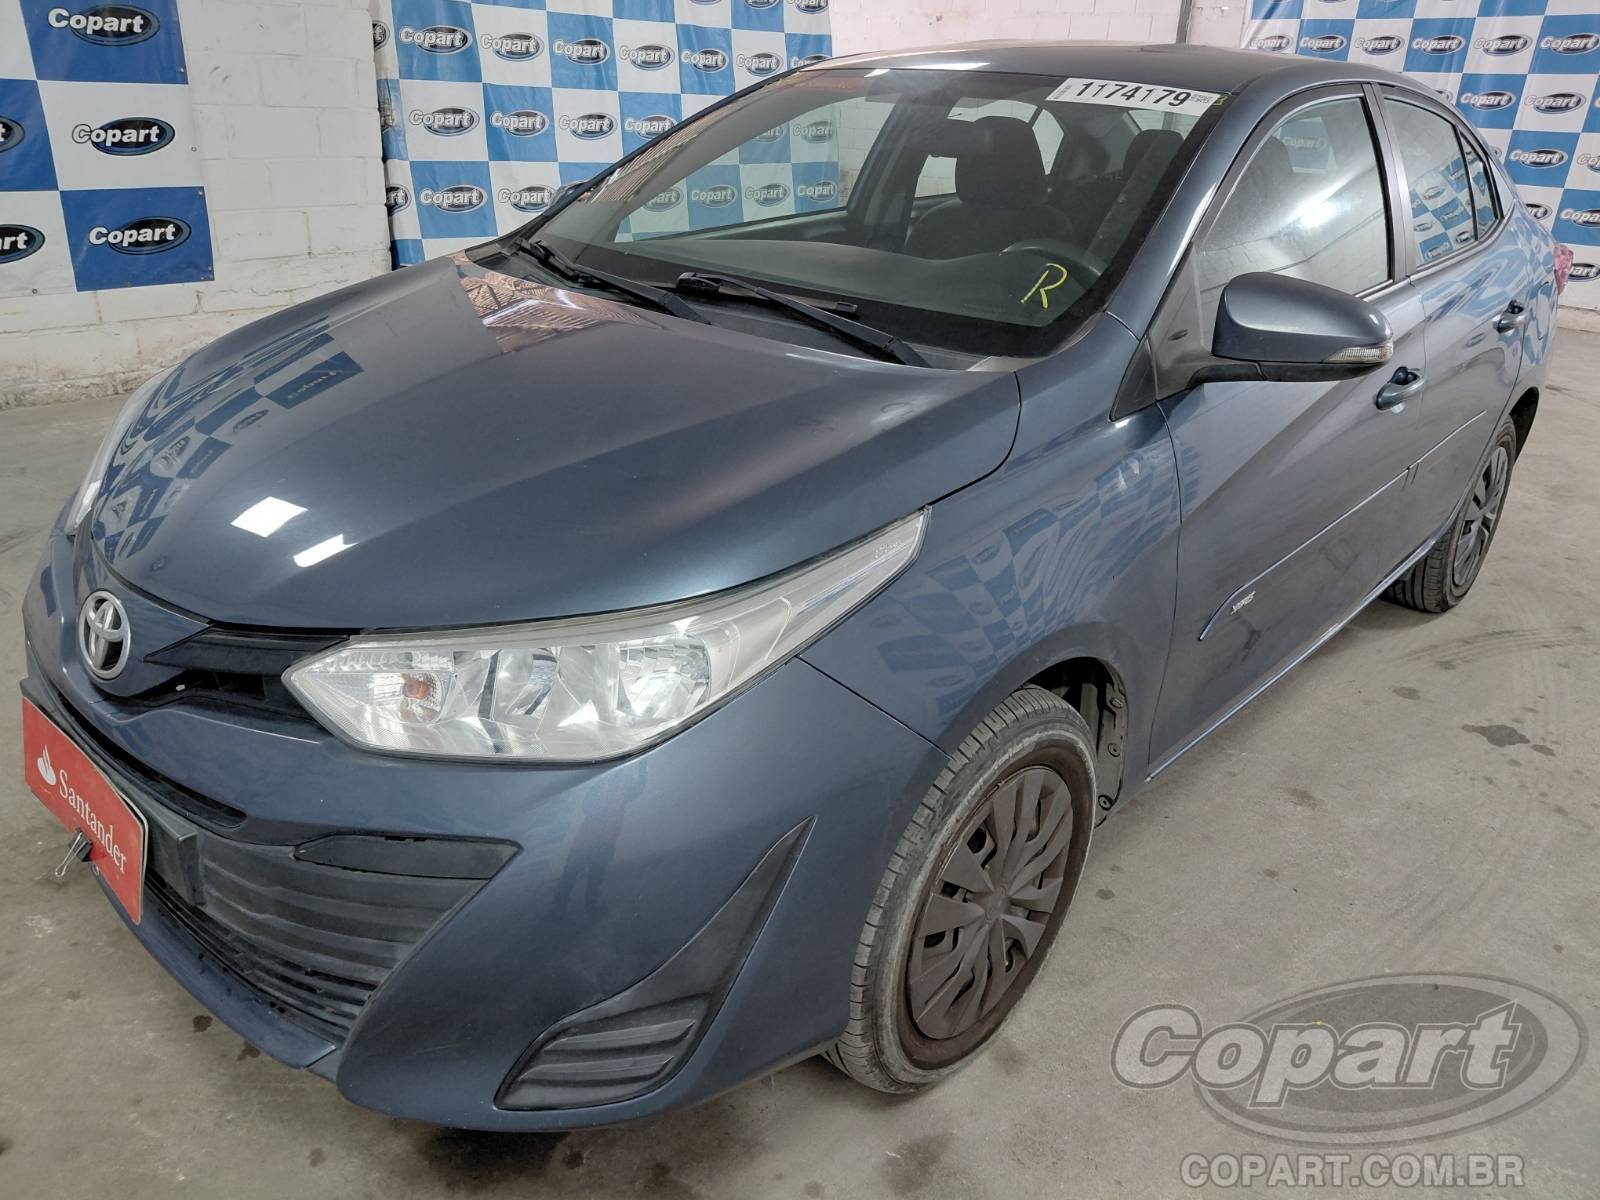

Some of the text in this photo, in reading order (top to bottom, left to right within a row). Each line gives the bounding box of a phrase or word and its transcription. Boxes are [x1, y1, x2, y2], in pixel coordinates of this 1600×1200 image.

[48, 8, 144, 34] Copart
[400, 27, 463, 47] Copart
[481, 34, 537, 54] Copart
[1300, 37, 1342, 50] Copart
[1354, 38, 1401, 51] Copart
[1412, 38, 1459, 51] Copart
[1474, 37, 1523, 51] Copart
[1541, 35, 1594, 50] Copart
[553, 40, 606, 60] Copart
[619, 46, 668, 63] Copart
[681, 51, 724, 67] Copart
[736, 54, 778, 72] Copart
[1076, 82, 1192, 107] 1174179
[1461, 91, 1509, 107] Copart
[1524, 94, 1578, 110] Copart
[409, 110, 474, 129] Copart
[490, 113, 544, 130] Copart
[559, 115, 611, 133] Copart
[625, 119, 671, 136] Copart
[72, 124, 160, 146] Copart
[1510, 149, 1560, 164] Copart
[420, 189, 481, 206] Copart
[498, 189, 551, 206] Copart
[692, 189, 732, 203] Copart
[745, 186, 784, 202] Copart
[797, 184, 834, 199] Copart
[89, 223, 176, 248] Copart
[1020, 262, 1068, 309] R
[58, 768, 128, 874] Santander
